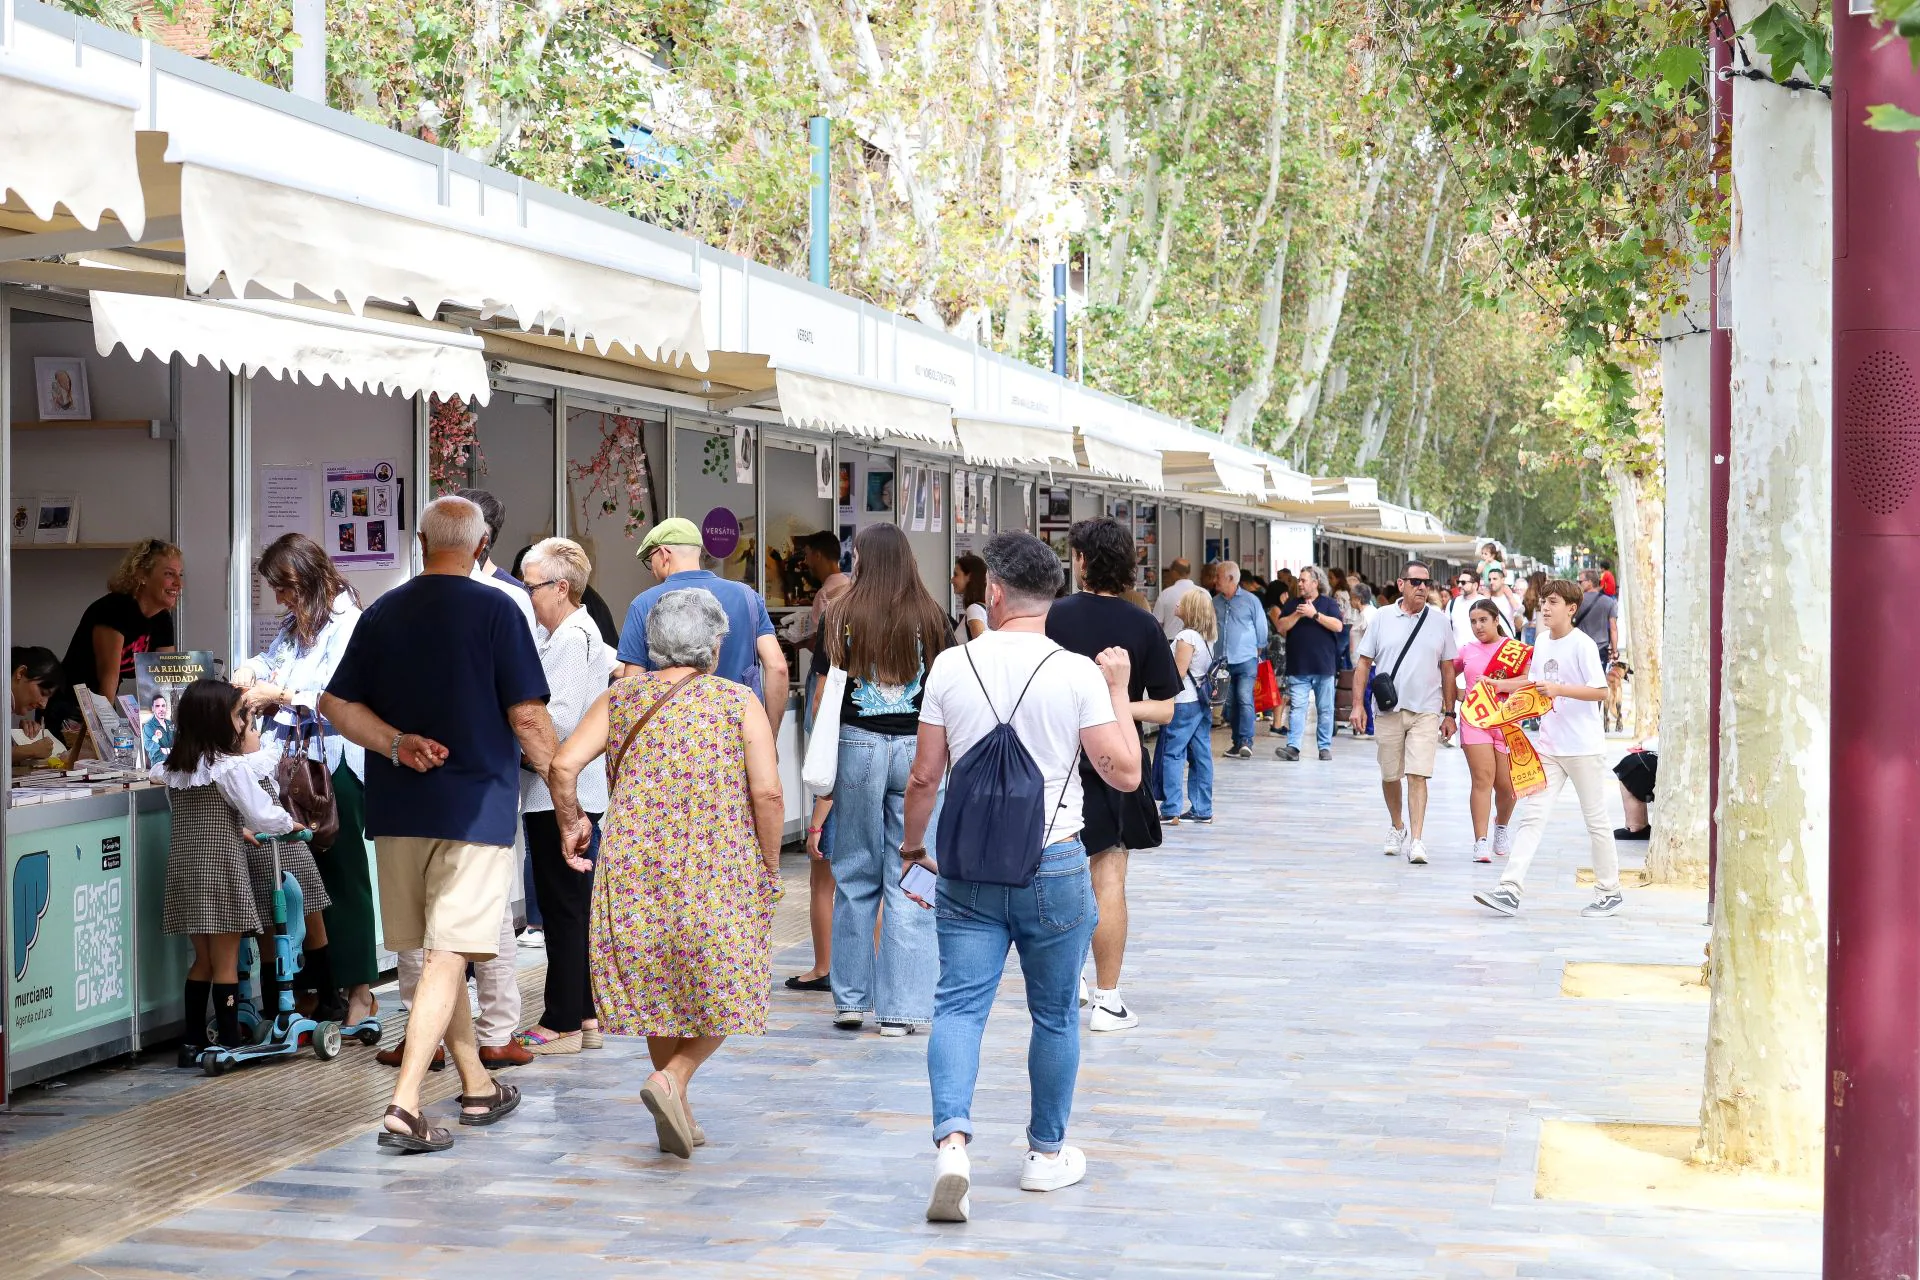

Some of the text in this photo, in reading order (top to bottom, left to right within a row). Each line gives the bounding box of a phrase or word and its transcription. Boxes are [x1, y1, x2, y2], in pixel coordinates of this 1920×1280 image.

[148, 664, 204, 674] LA RELIQUIA
[15, 985, 53, 1008] murcianeo
[15, 1012, 34, 1029] Agenda
